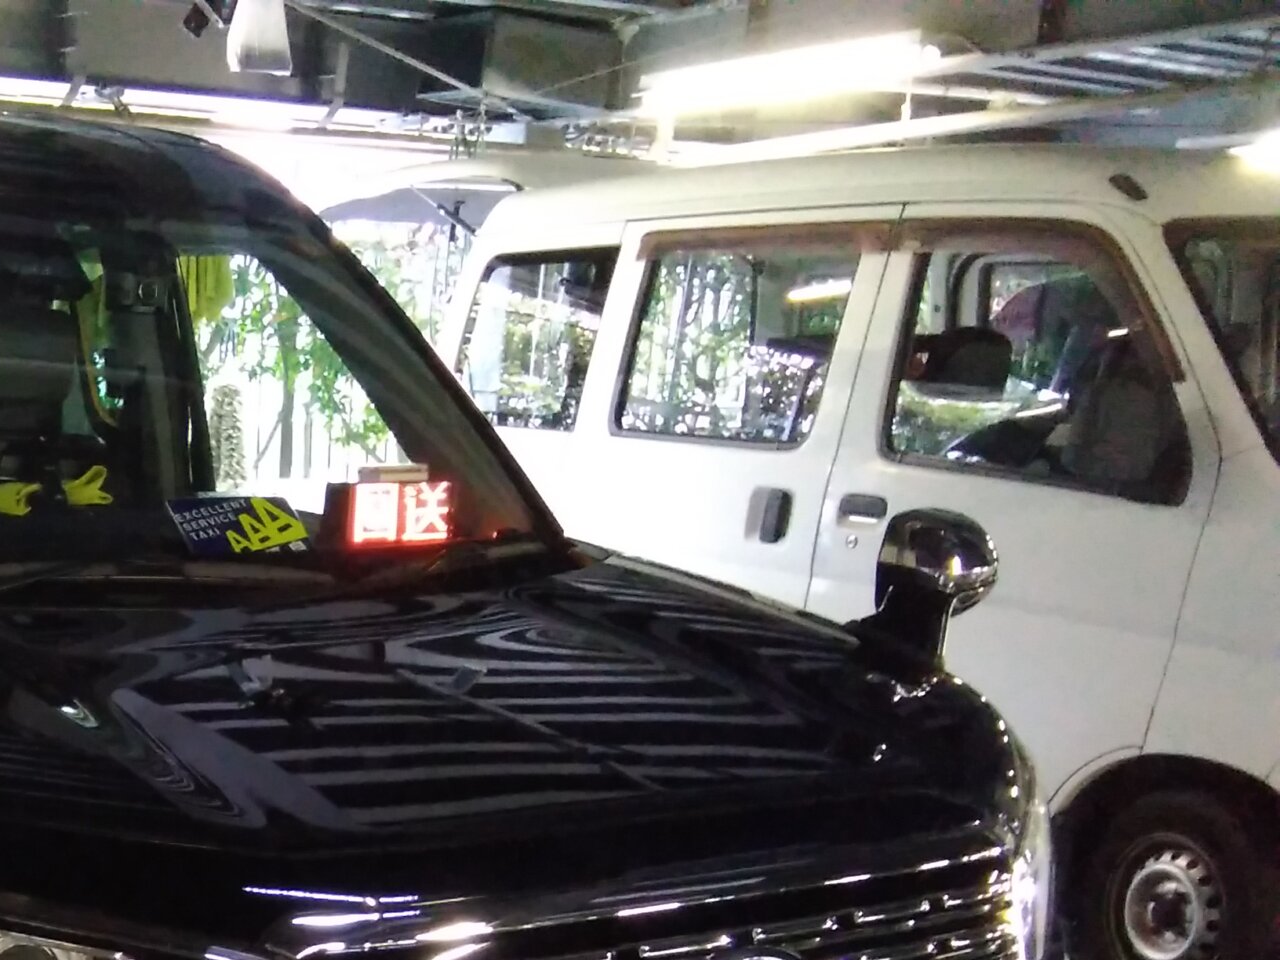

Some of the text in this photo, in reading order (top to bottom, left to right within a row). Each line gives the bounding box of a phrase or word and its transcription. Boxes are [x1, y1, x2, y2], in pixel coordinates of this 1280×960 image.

[174, 499, 247, 522] EXCELLENT
[353, 481, 450, 544] 回送
[182, 512, 237, 532] SERVICE
[189, 528, 220, 541] TAXI
